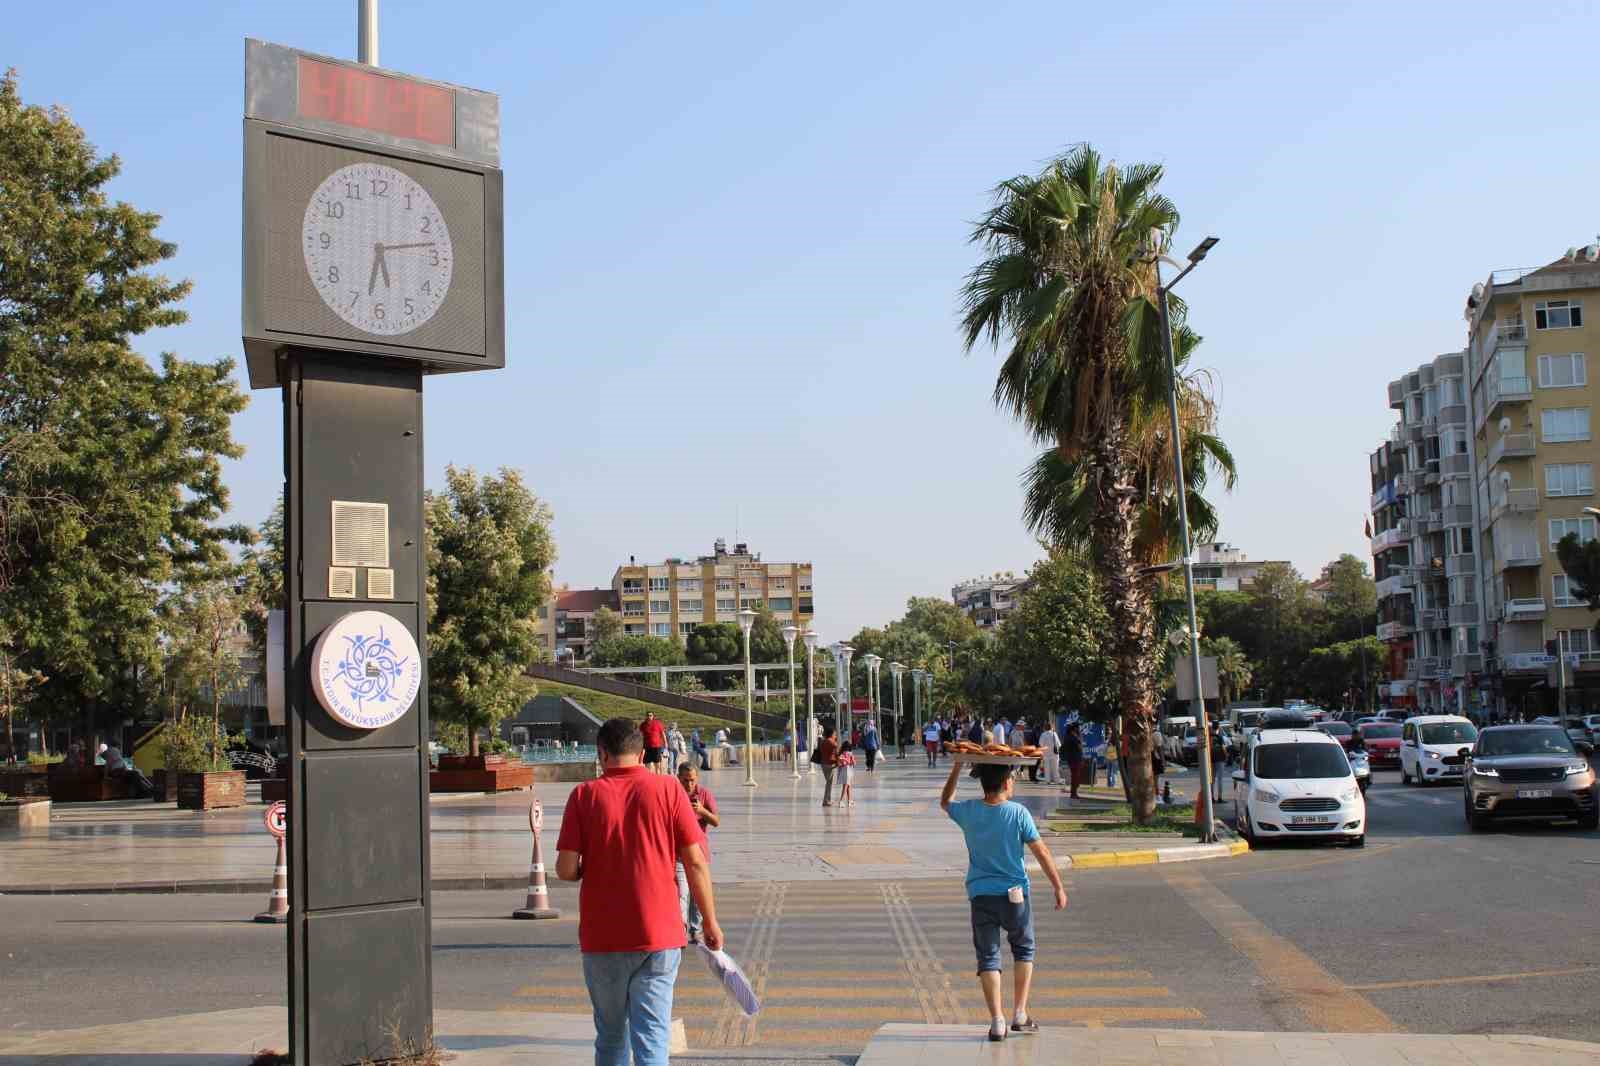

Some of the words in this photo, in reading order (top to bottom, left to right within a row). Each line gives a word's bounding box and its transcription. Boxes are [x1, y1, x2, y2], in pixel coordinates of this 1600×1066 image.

[345, 182, 362, 200] 11
[370, 179, 389, 197] 12
[326, 200, 345, 219] 10
[403, 194, 412, 210] 1
[420, 216, 431, 233] 2
[319, 232, 331, 250] 9
[429, 249, 440, 266] 3
[327, 265, 340, 284] 8
[421, 280, 432, 296] 4
[350, 291, 360, 308] 7
[403, 298, 414, 315] 5
[374, 302, 385, 320] 6
